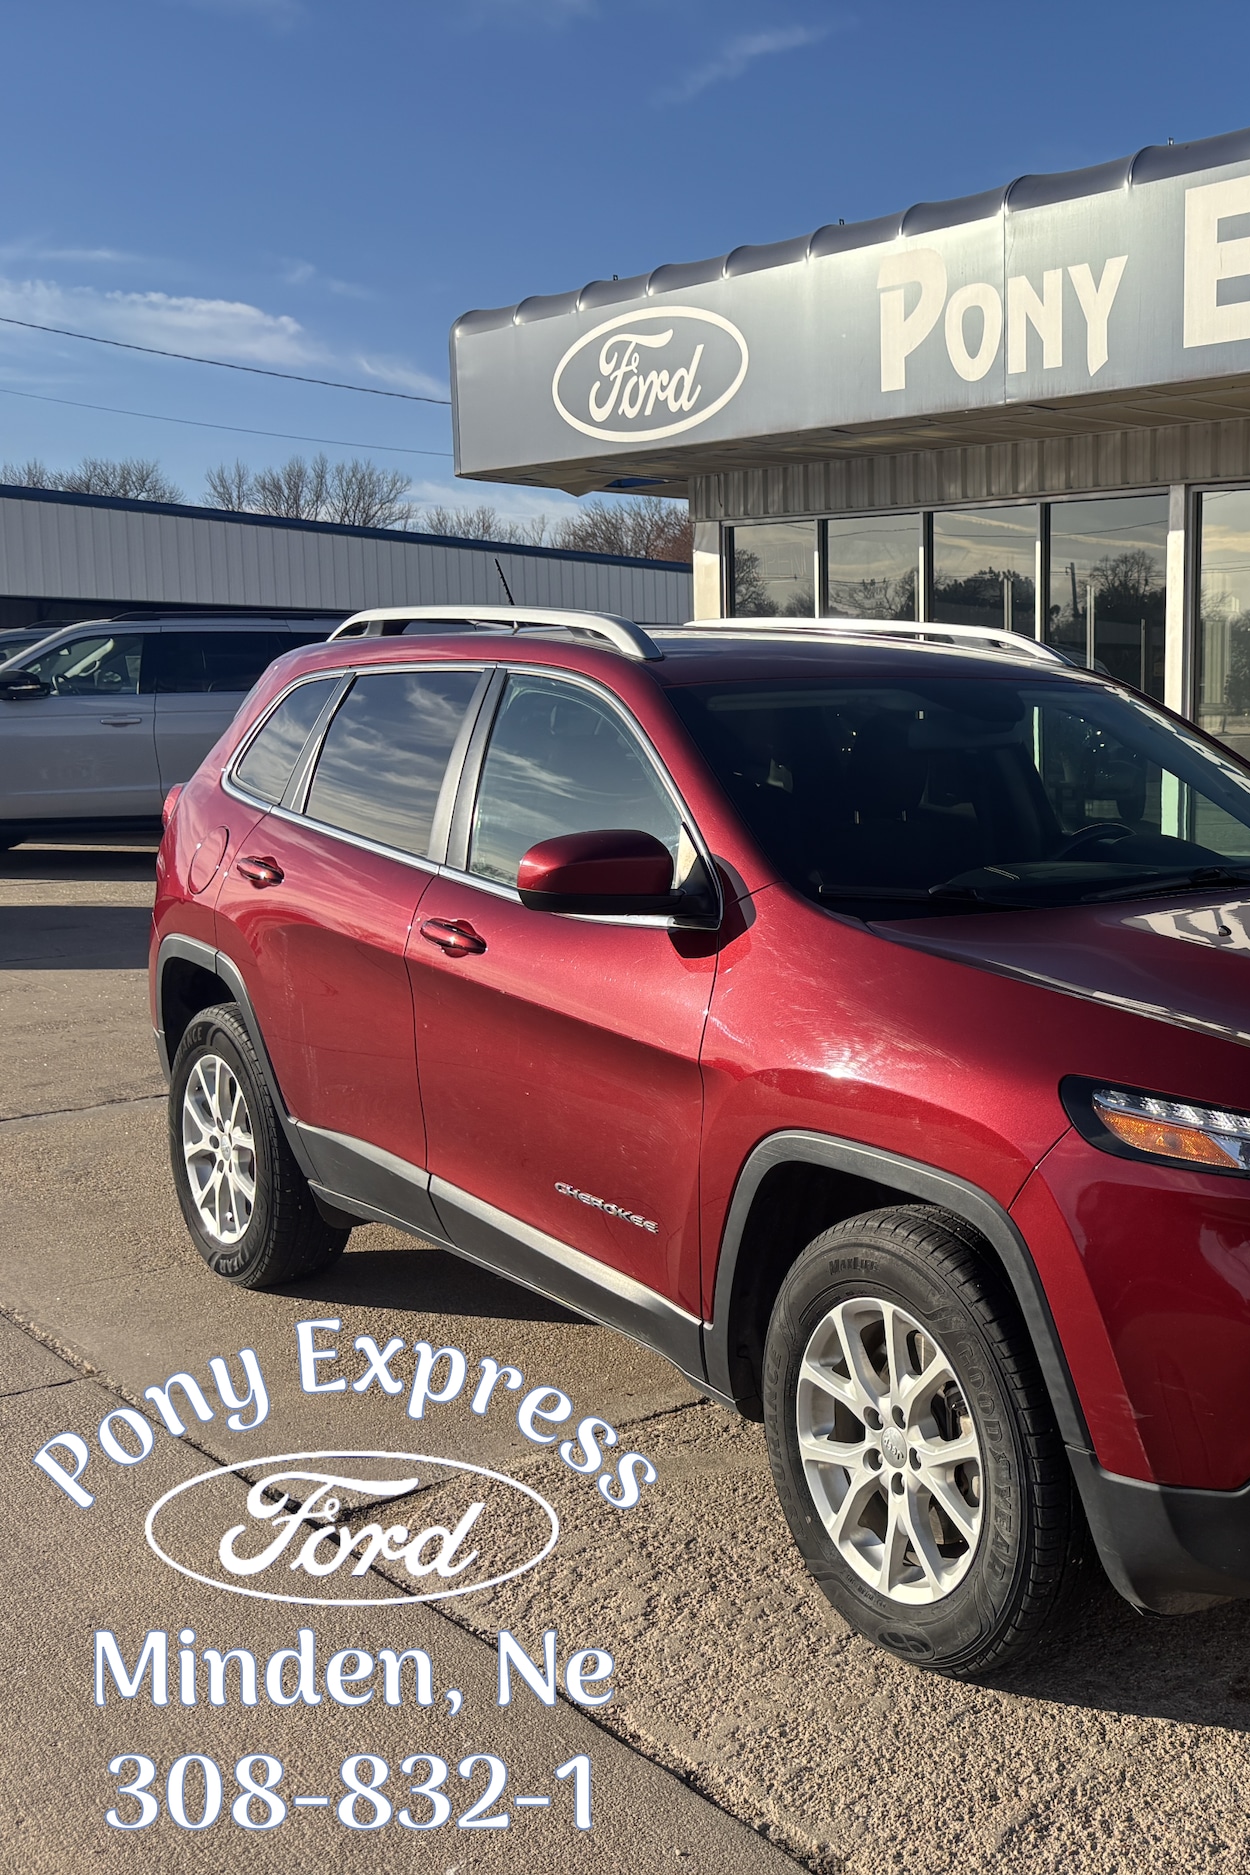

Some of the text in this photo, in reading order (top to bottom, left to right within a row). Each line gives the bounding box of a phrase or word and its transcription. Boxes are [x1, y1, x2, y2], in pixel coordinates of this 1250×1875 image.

[588, 328, 705, 422] Ford
[554, 1181, 660, 1234] CHEROKEE
[956, 1339, 1013, 1582] GOODYEAR
